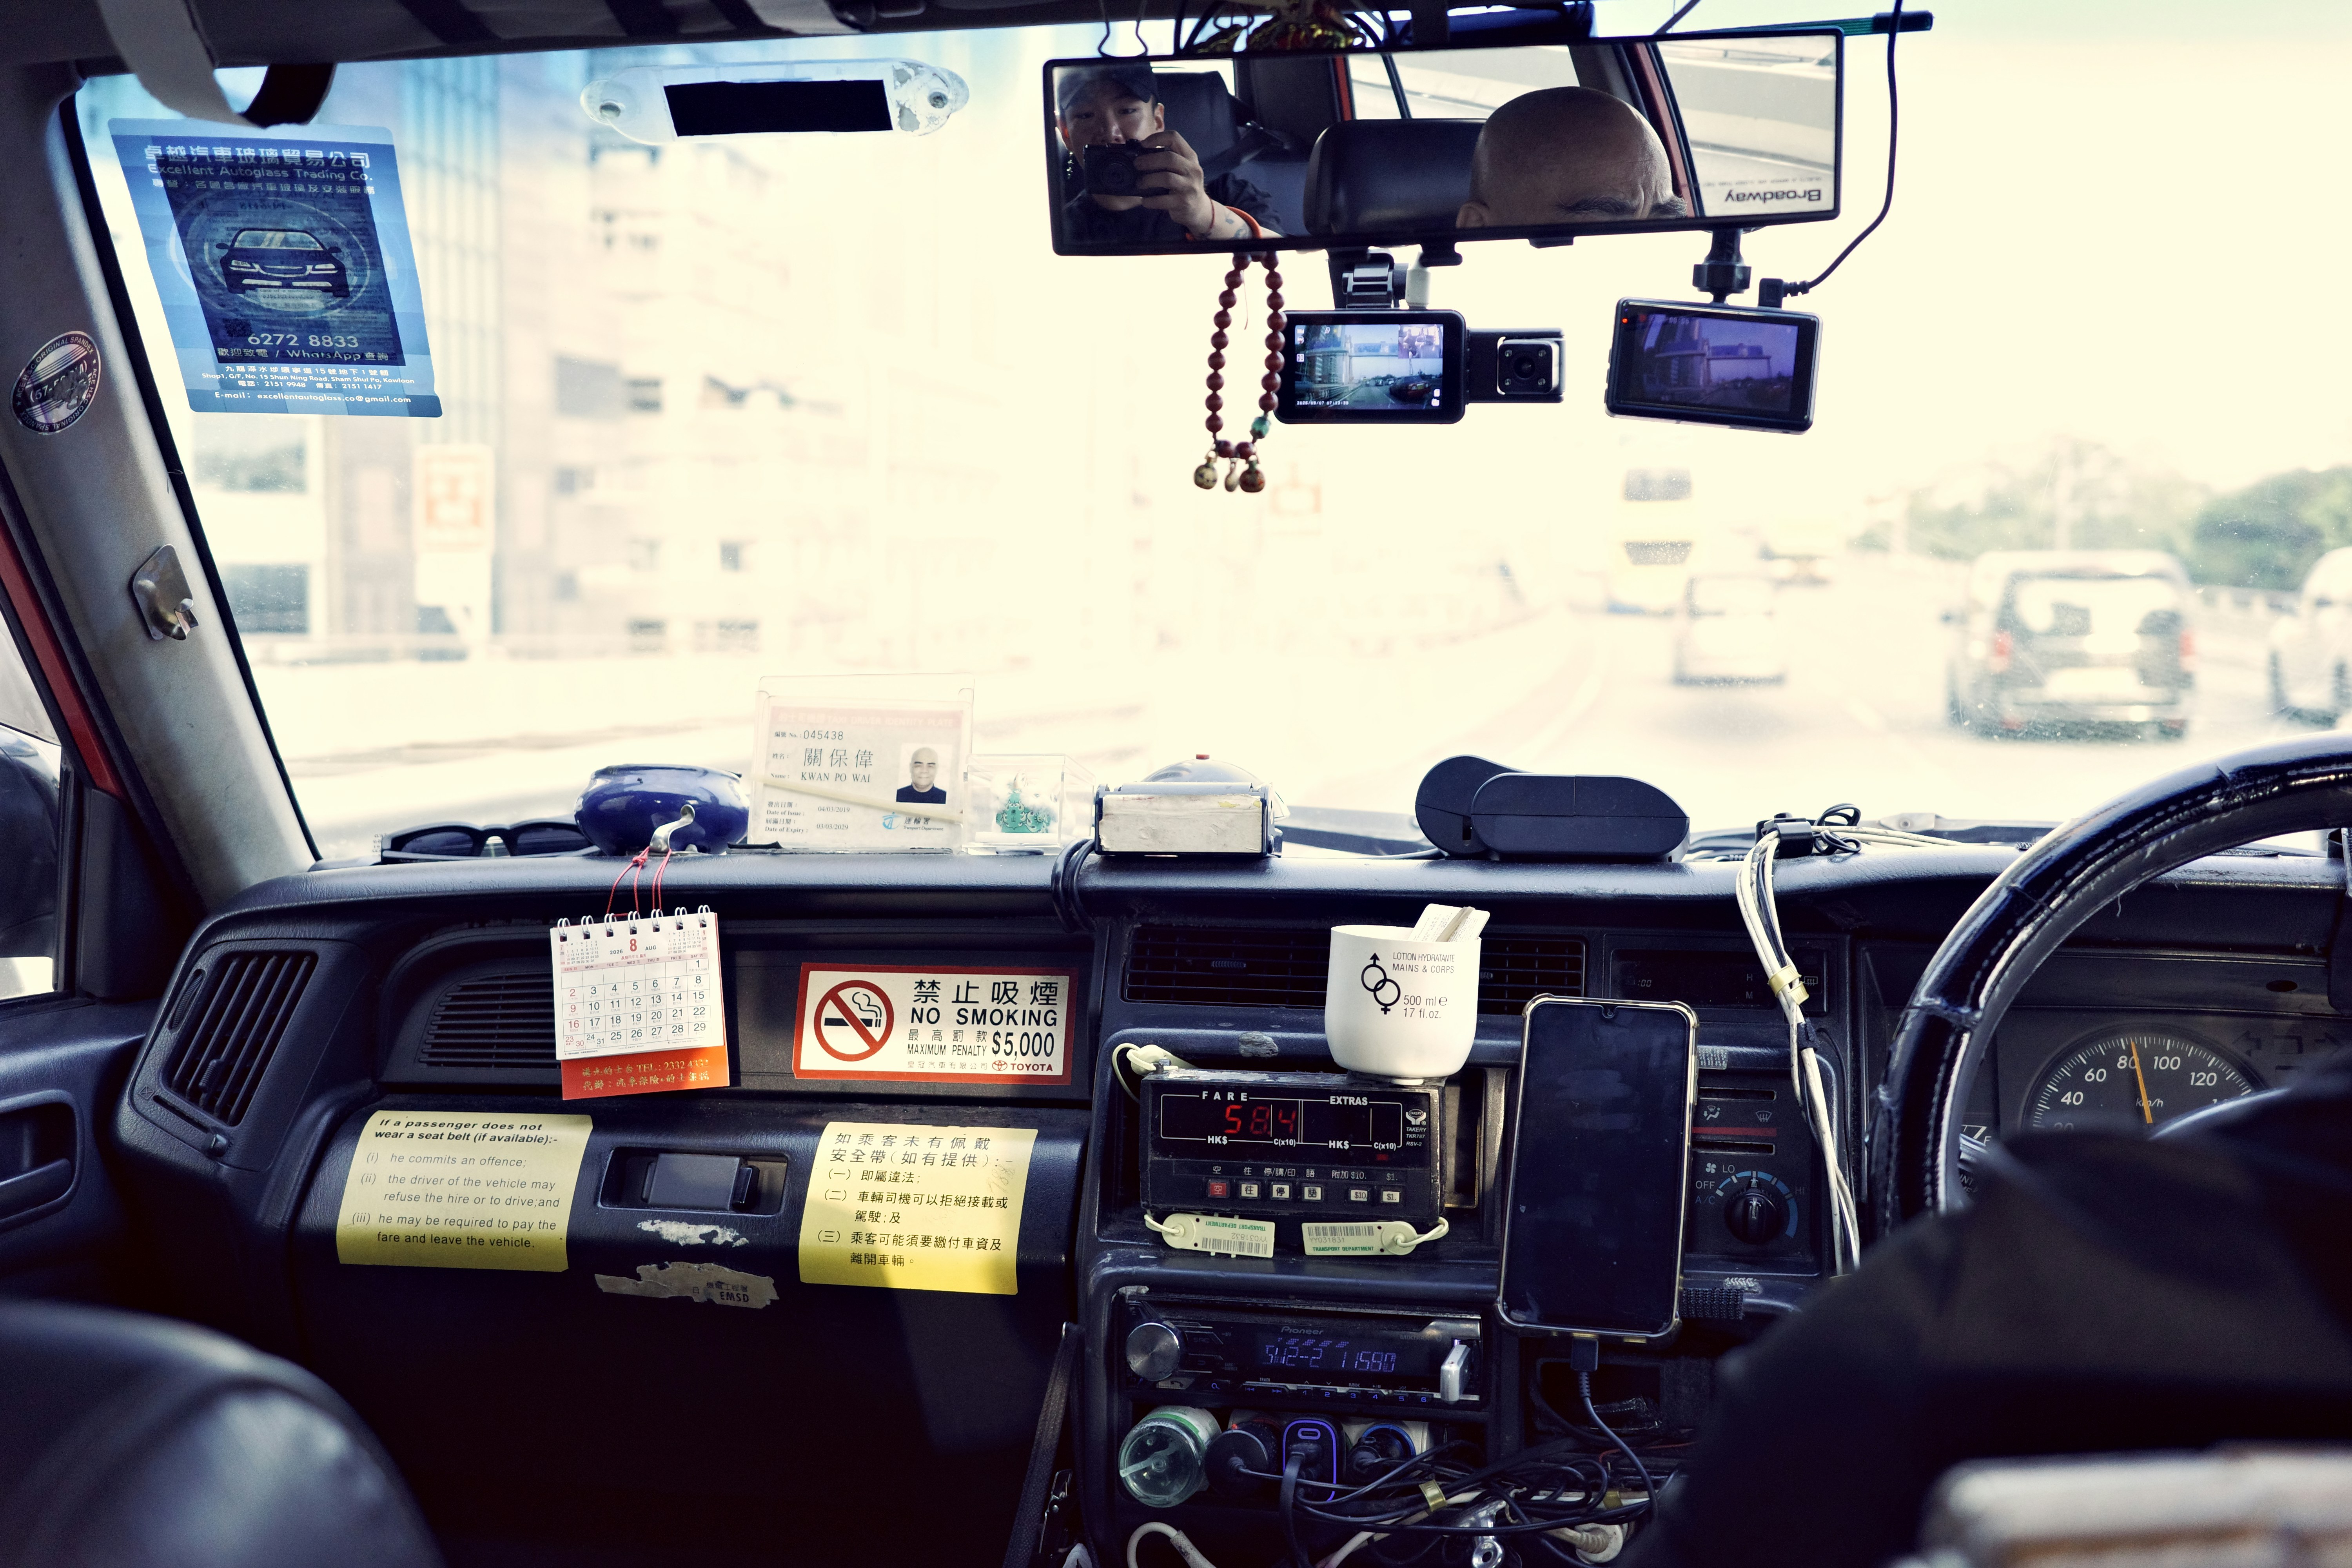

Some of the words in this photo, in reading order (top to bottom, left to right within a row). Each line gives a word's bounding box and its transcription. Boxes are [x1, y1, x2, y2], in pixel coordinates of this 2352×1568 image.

[145, 145, 370, 168] 卓越汽車玻璃貿易公司
[147, 164, 214, 175] Excellent
[220, 166, 289, 179] Autoglass
[296, 169, 345, 181] Trading
[350, 171, 374, 181] Co.
[1725, 189, 1821, 203] Broadway
[248, 333, 299, 346] 6272
[309, 335, 359, 348] 8833
[218, 347, 268, 358] 歡迎致電
[287, 349, 361, 361] WhatsApp
[365, 352, 388, 361] 查詢
[16, 382, 26, 398] ACE
[22, 363, 36, 381] H&C
[36, 338, 68, 363] ORIGINAL
[70, 336, 94, 355] SPANDEX
[257, 393, 411, 403] excellentautoglass.co@gmail.com
[803, 730, 844, 740] 045438
[804, 748, 874, 768] 關保偉
[801, 772, 830, 781] KWAN
[835, 773, 847, 782] PO
[852, 773, 871, 782] WAI
[630, 938, 637, 951] 8
[1393, 952, 1416, 961] LOTION
[1418, 953, 1455, 962] HYDRATANTE
[1392, 964, 1419, 972] MAINS
[913, 979, 1058, 1005] 禁止吸煙
[1404, 995, 1421, 1006] 500
[1425, 996, 1436, 1006] ml
[911, 1007, 940, 1024] NO
[956, 1008, 1058, 1026] SMOKING
[1404, 1008, 1415, 1018] 17
[907, 1044, 946, 1055] MAXIMUM
[952, 1045, 987, 1056] PENALTY
[908, 1029, 987, 1042] 最高罰款
[992, 1030, 1054, 1060] $5,000
[664, 1060, 685, 1070] 2332
[907, 1061, 987, 1070] 皇冠汽車有限公司
[2084, 1069, 2107, 1082] 60
[2153, 1056, 2181, 1070] 100
[2190, 1072, 2217, 1086] 120
[1202, 1091, 1247, 1101] FARE
[1330, 1096, 1368, 1105] EXTRAS
[2060, 1091, 2084, 1106] 40
[405, 1121, 477, 1131] passenger
[375, 1131, 405, 1139] wear
[418, 1132, 444, 1140] seat
[447, 1132, 470, 1141] belt
[474, 1133, 487, 1143] (if
[835, 1132, 991, 1150] 如乘客未有佩戴
[1208, 1136, 1228, 1145] HK$
[1274, 1138, 1296, 1147] C(x10)
[1329, 1141, 1349, 1149] HK$
[1374, 1142, 1396, 1151] C(x10)
[366, 1152, 379, 1164] (i)
[390, 1153, 404, 1163] he
[409, 1154, 456, 1165] commits
[461, 1157, 475, 1165] an
[480, 1157, 526, 1168] offence;
[1212, 1166, 1221, 1174] 空
[1243, 1167, 1252, 1175] 往
[1306, 1169, 1315, 1177] 語
[1332, 1170, 1348, 1179] 附加
[1351, 1171, 1367, 1180] $10.
[1386, 1173, 1398, 1181] $1.
[1722, 1165, 1735, 1173] LO
[361, 1173, 376, 1185] (ii)
[388, 1174, 406, 1184] the
[410, 1175, 444, 1185] driver
[448, 1176, 460, 1186] of
[463, 1176, 481, 1187] the
[486, 1178, 526, 1189] vehicle
[531, 1180, 555, 1192] may
[1695, 1181, 1715, 1189] OFF
[857, 1191, 1008, 1209] 車輛司機可以拒絕接載或
[1695, 1196, 1715, 1205] A/C
[352, 1212, 370, 1225] (iii)
[378, 1214, 392, 1224] he
[397, 1216, 421, 1227] may
[425, 1215, 440, 1226] be
[444, 1216, 493, 1229] required
[497, 1219, 508, 1229] to
[512, 1220, 534, 1232] pay
[538, 1220, 557, 1230] the
[377, 1232, 400, 1243] fare
[405, 1232, 425, 1243] and
[431, 1234, 462, 1245] leave
[466, 1235, 485, 1246] the
[490, 1236, 535, 1248] vehicle.
[850, 1231, 1002, 1251] 乘客可能須要繳付車資及
[720, 1291, 749, 1303] EMSD
[1281, 1326, 1324, 1335] Pioneer
